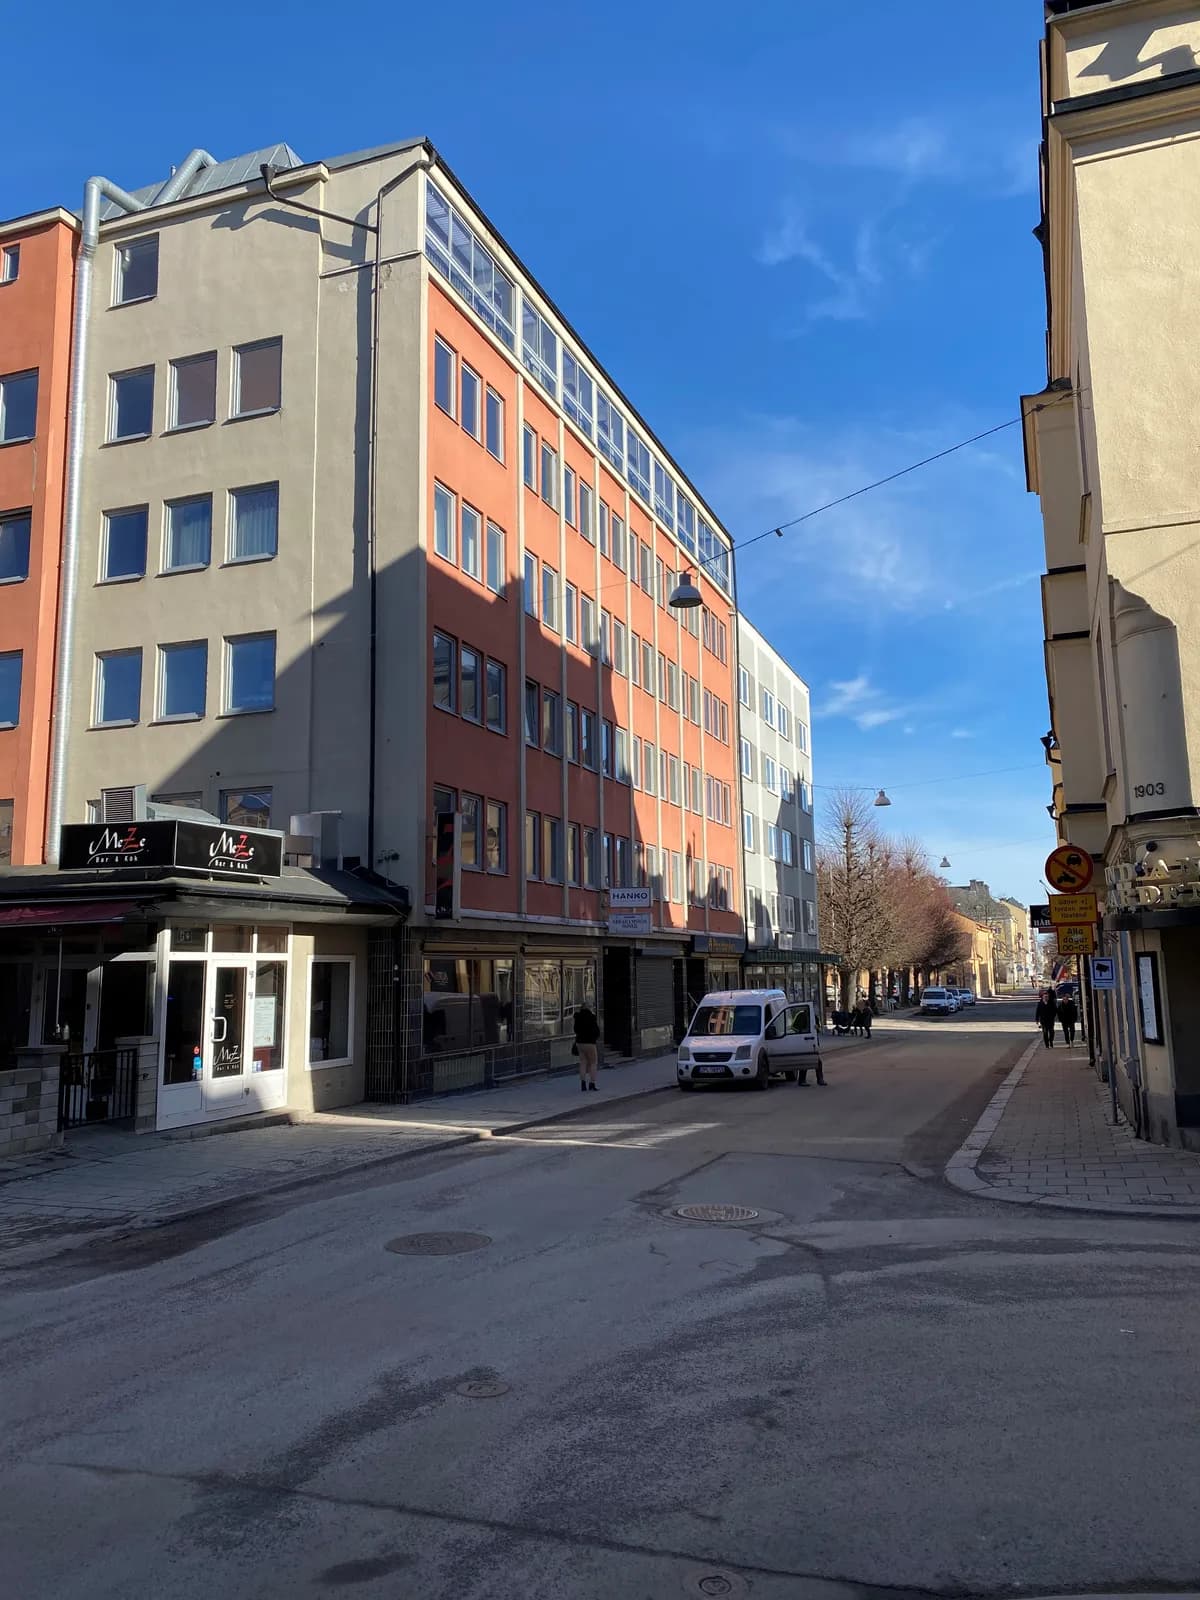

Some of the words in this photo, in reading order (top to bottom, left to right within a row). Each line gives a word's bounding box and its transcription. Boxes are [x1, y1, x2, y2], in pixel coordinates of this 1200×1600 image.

[1134, 782, 1165, 798] 1903
[612, 892, 648, 900] HANKO
[1066, 927, 1084, 935] Alla
